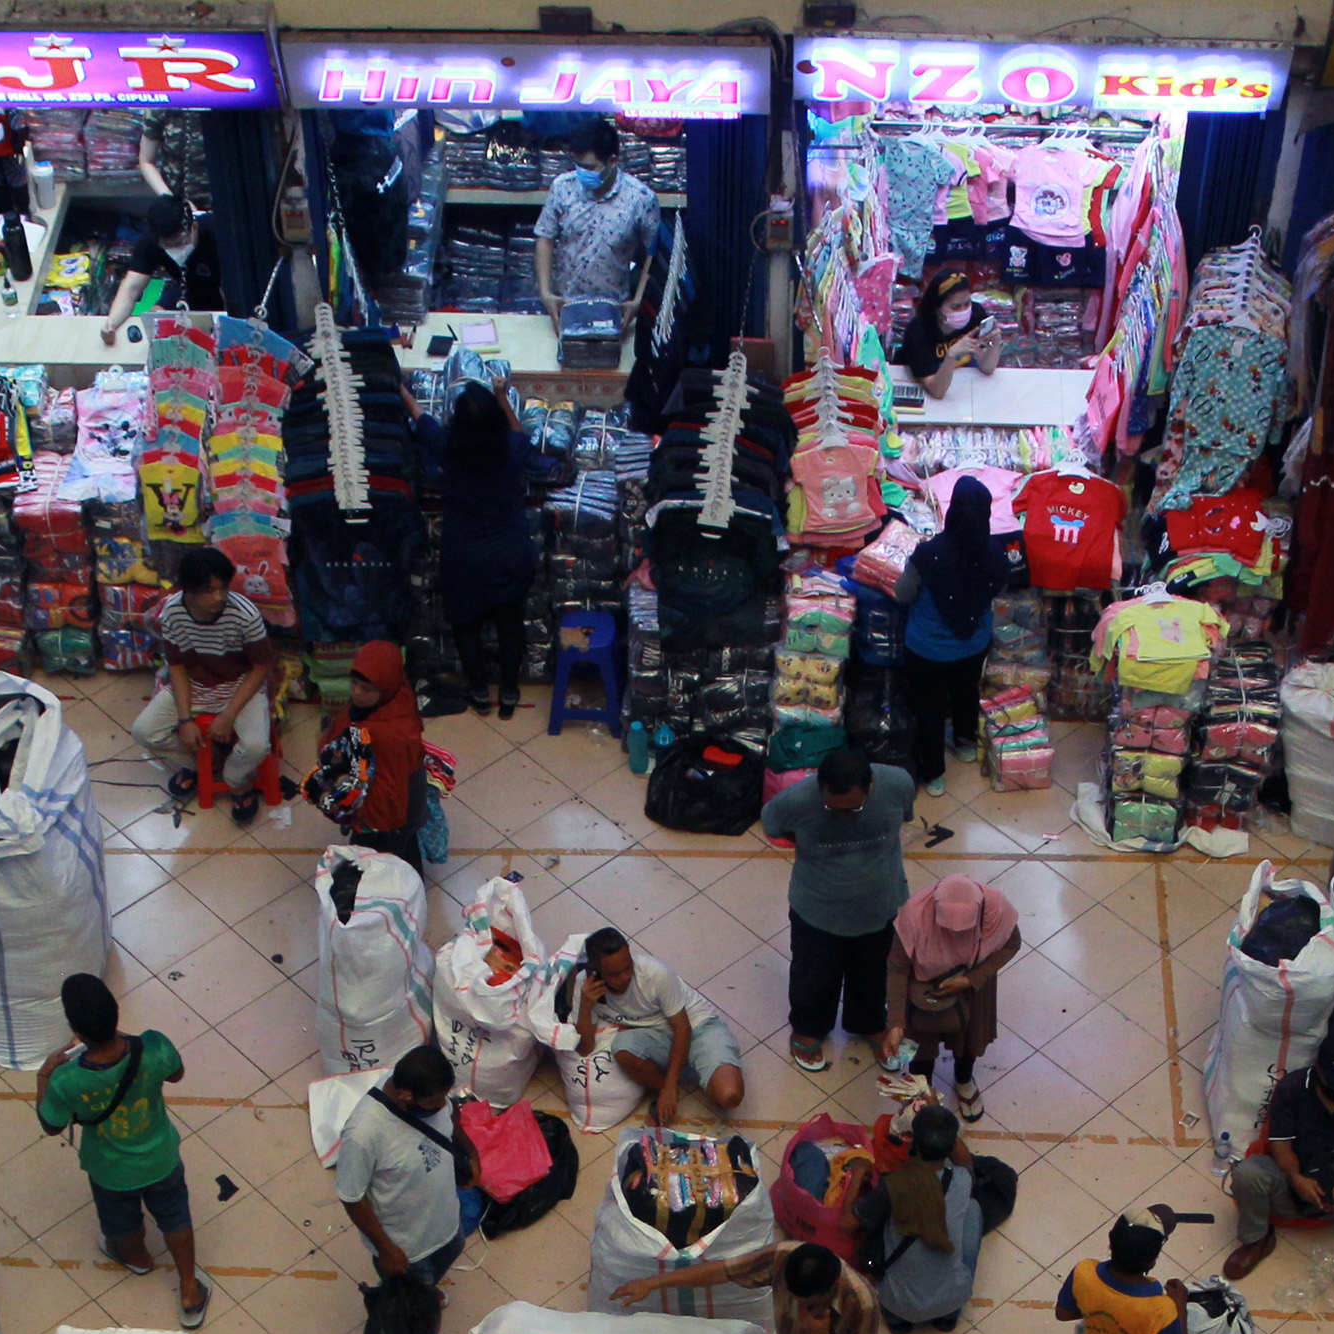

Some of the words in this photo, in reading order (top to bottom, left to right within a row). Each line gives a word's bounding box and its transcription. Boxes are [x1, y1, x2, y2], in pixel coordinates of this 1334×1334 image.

[8, 93, 39, 102] HALL
[43, 93, 67, 102] NO.
[117, 93, 169, 103] CIPULIR
[520, 60, 743, 105] JAYA
[812, 50, 1074, 104] NZO
[1097, 74, 1271, 99] Kid's
